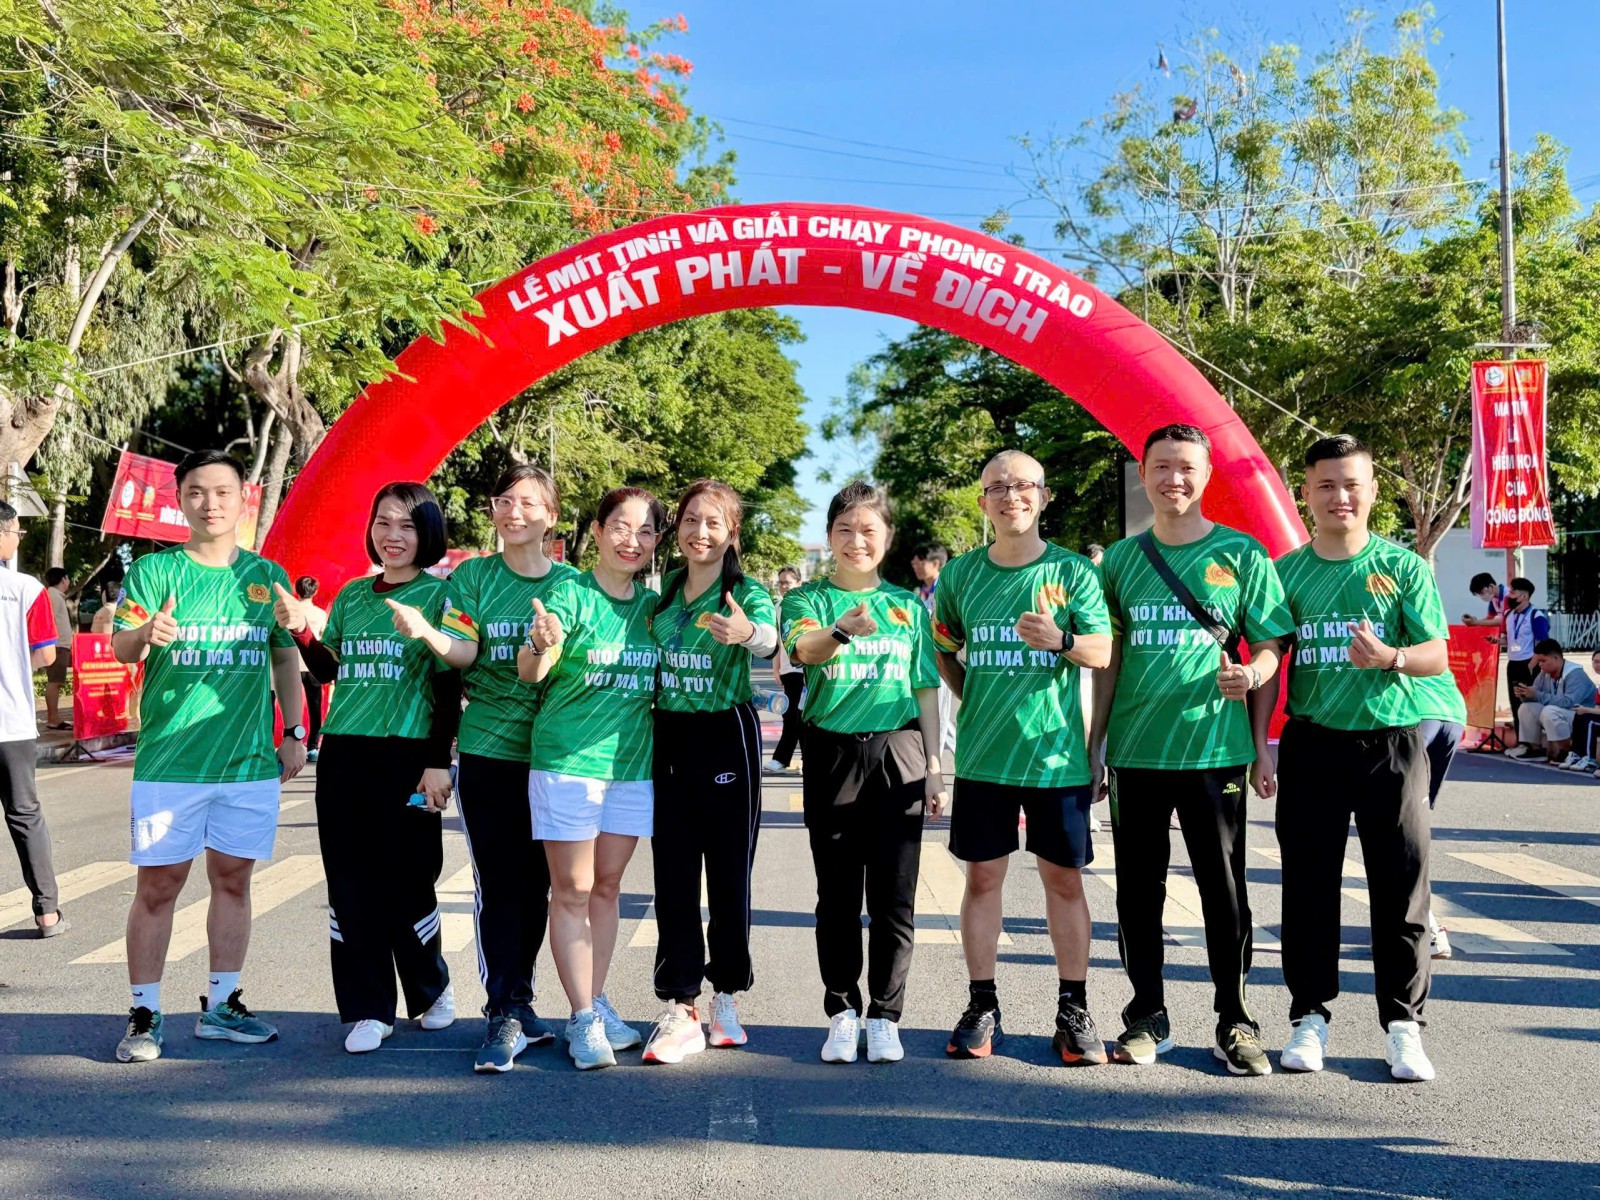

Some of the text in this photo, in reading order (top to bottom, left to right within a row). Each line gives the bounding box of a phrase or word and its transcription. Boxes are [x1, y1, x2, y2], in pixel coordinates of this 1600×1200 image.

[507, 210, 1094, 318] LỄ MÍT TINH VÀ GIẢI CHẠY PHONG TRÀO
[534, 241, 1049, 347] XUẤT PHÁT - VỀ ĐÍCH
[1505, 476, 1527, 497] CỦA
[1486, 500, 1549, 529] CỘNG ĐỒNG
[211, 621, 268, 643] KHÔNG
[486, 619, 518, 639] NÓI
[1157, 629, 1186, 645] MA
[171, 646, 267, 667] VỚI MA TÚY
[356, 636, 405, 658] KHÔNG
[490, 641, 514, 661] VỚI
[995, 650, 1024, 667] MA
[354, 662, 376, 678] MA
[378, 660, 405, 681] TÚY
[584, 669, 612, 687] VỚI
[613, 673, 639, 690] MA
[850, 663, 879, 680] MA
[682, 674, 715, 693] TÚY
